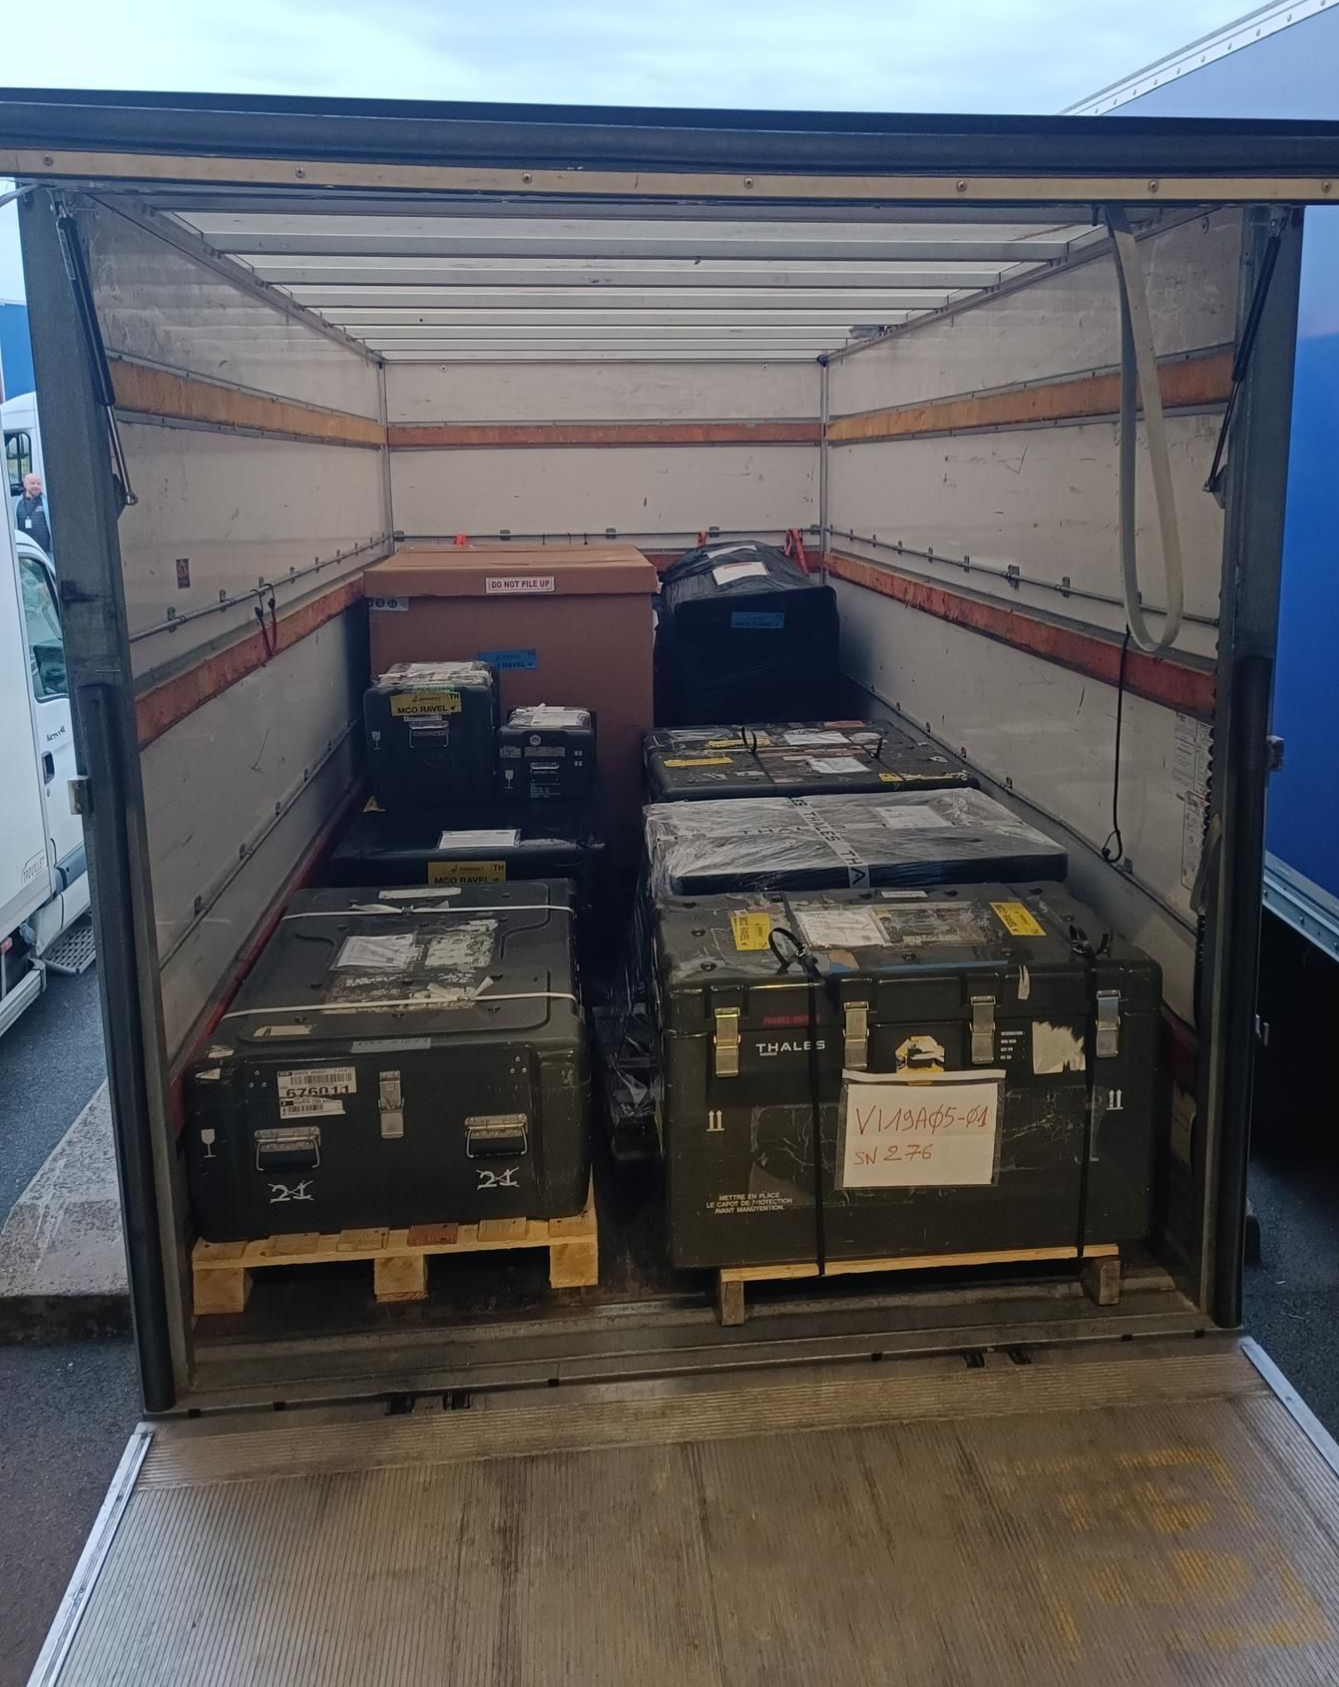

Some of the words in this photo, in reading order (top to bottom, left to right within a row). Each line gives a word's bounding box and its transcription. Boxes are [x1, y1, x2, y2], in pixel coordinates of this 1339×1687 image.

[491, 580, 502, 588] DO
[504, 580, 519, 588] NOT
[521, 579, 538, 588] PILE
[539, 579, 550, 587] UP
[397, 706, 418, 715] MCO
[420, 704, 448, 714] RAVEL
[803, 811, 841, 843] THALES
[493, 864, 504, 872] TH
[434, 876, 457, 885] MCO
[755, 1039, 826, 1053] THALES
[286, 1085, 350, 1098] 676011
[853, 1145, 878, 1166] SN
[882, 1143, 934, 1162] 276
[718, 1193, 746, 1201] METTRE
[759, 1191, 780, 1199] PLACE
[706, 1201, 715, 1209] LE
[716, 1200, 739, 1208] CAPOT
